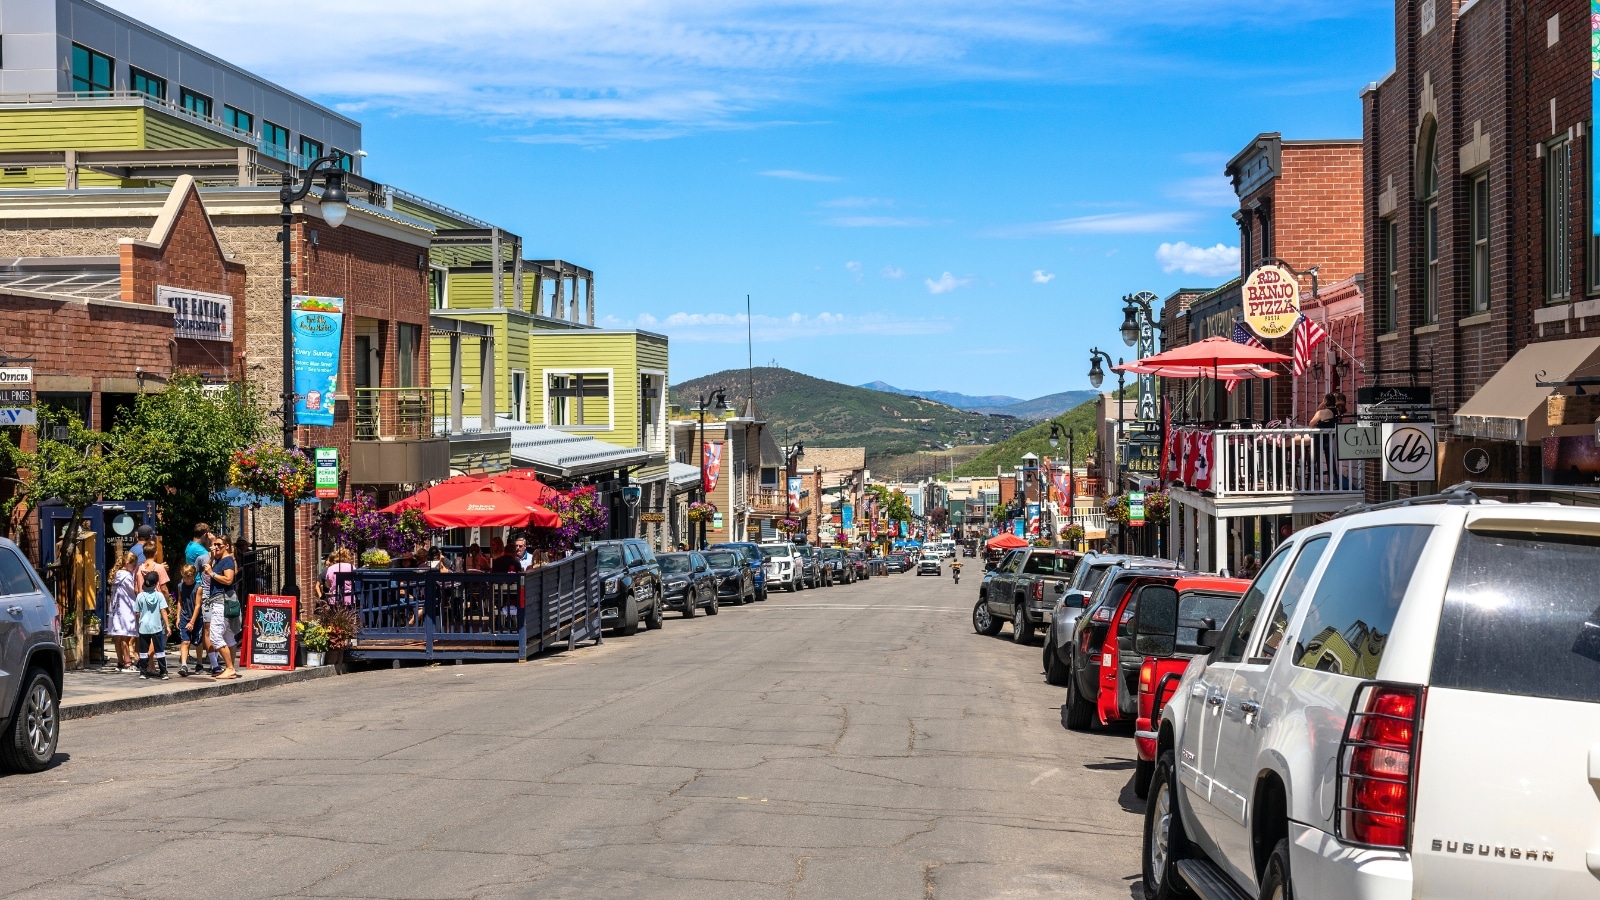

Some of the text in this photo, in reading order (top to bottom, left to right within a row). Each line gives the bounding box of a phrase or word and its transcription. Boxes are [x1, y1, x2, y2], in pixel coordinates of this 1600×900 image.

[1257, 271, 1281, 285] RED
[1247, 283, 1294, 301] BANJO
[168, 297, 227, 320] THE EATING
[1249, 299, 1295, 317] PIZZA
[295, 348, 334, 359] Every Sunday
[11, 390, 30, 401] PINES
[1388, 433, 1430, 463] db
[255, 596, 292, 604] Budweiser
[1431, 839, 1554, 862] SUBURBAN
